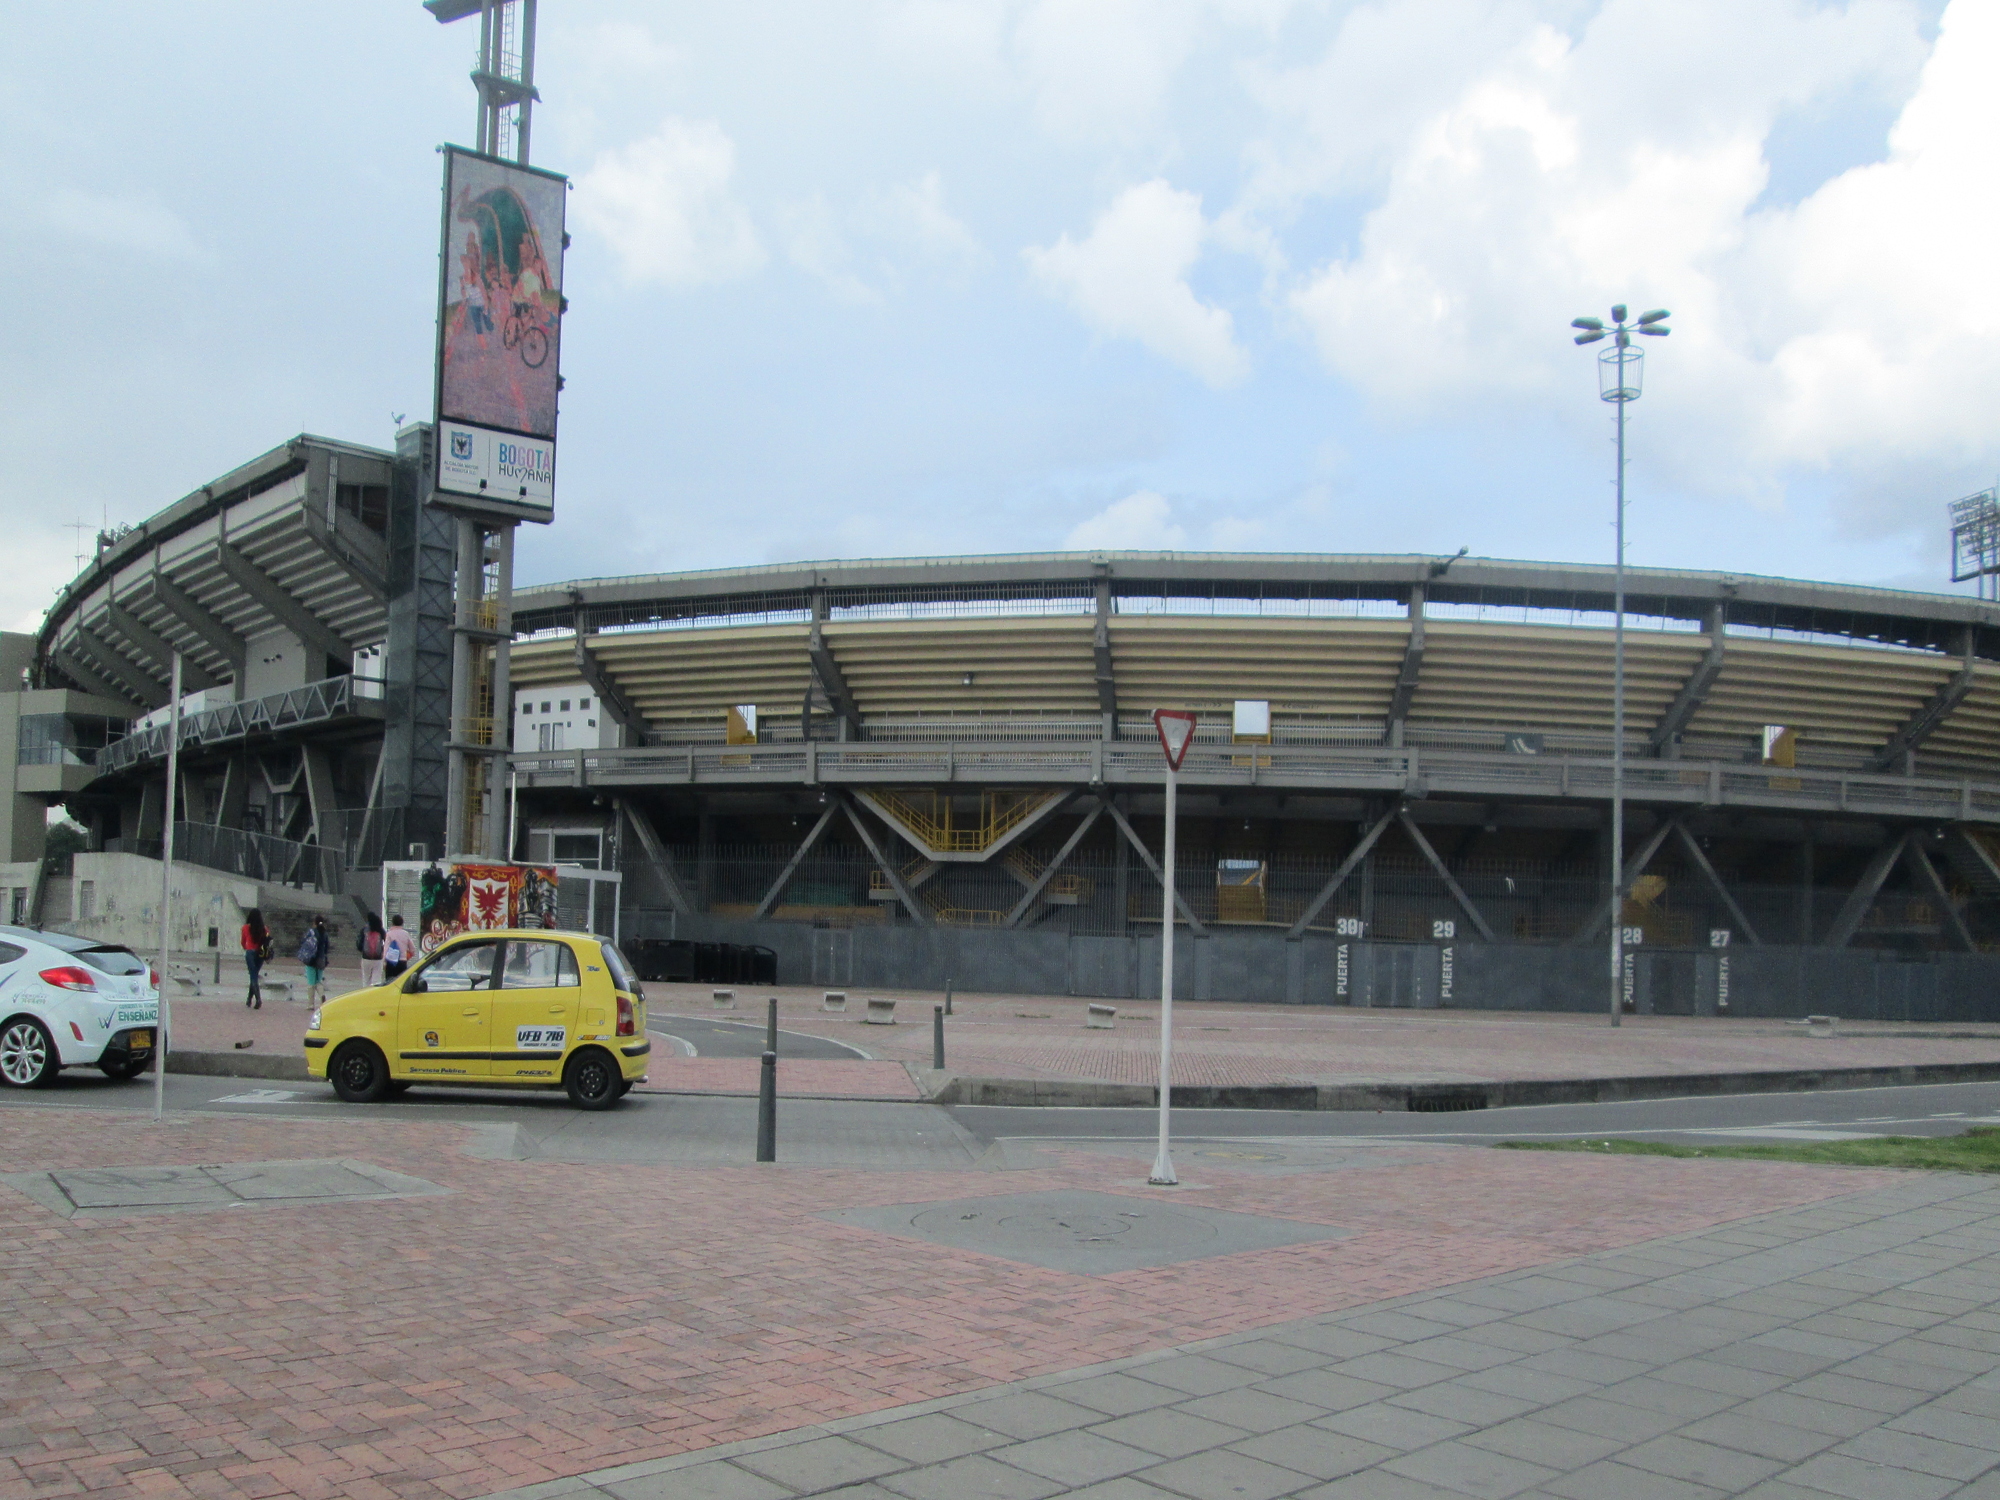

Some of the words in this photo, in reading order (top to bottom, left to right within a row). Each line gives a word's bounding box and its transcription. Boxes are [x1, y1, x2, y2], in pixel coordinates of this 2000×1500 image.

[1433, 920, 1455, 938] 29
[1622, 927, 1643, 944] 28
[1711, 930, 1730, 947] 27
[1337, 944, 1348, 995] PUERTA
[1442, 947, 1453, 998] PUERTA
[1624, 953, 1634, 1004] PUERTA
[1719, 956, 1729, 1006] PUERTA
[118, 1009, 158, 1022] ENSEÑANZ
[546, 1030, 565, 1042] 718
